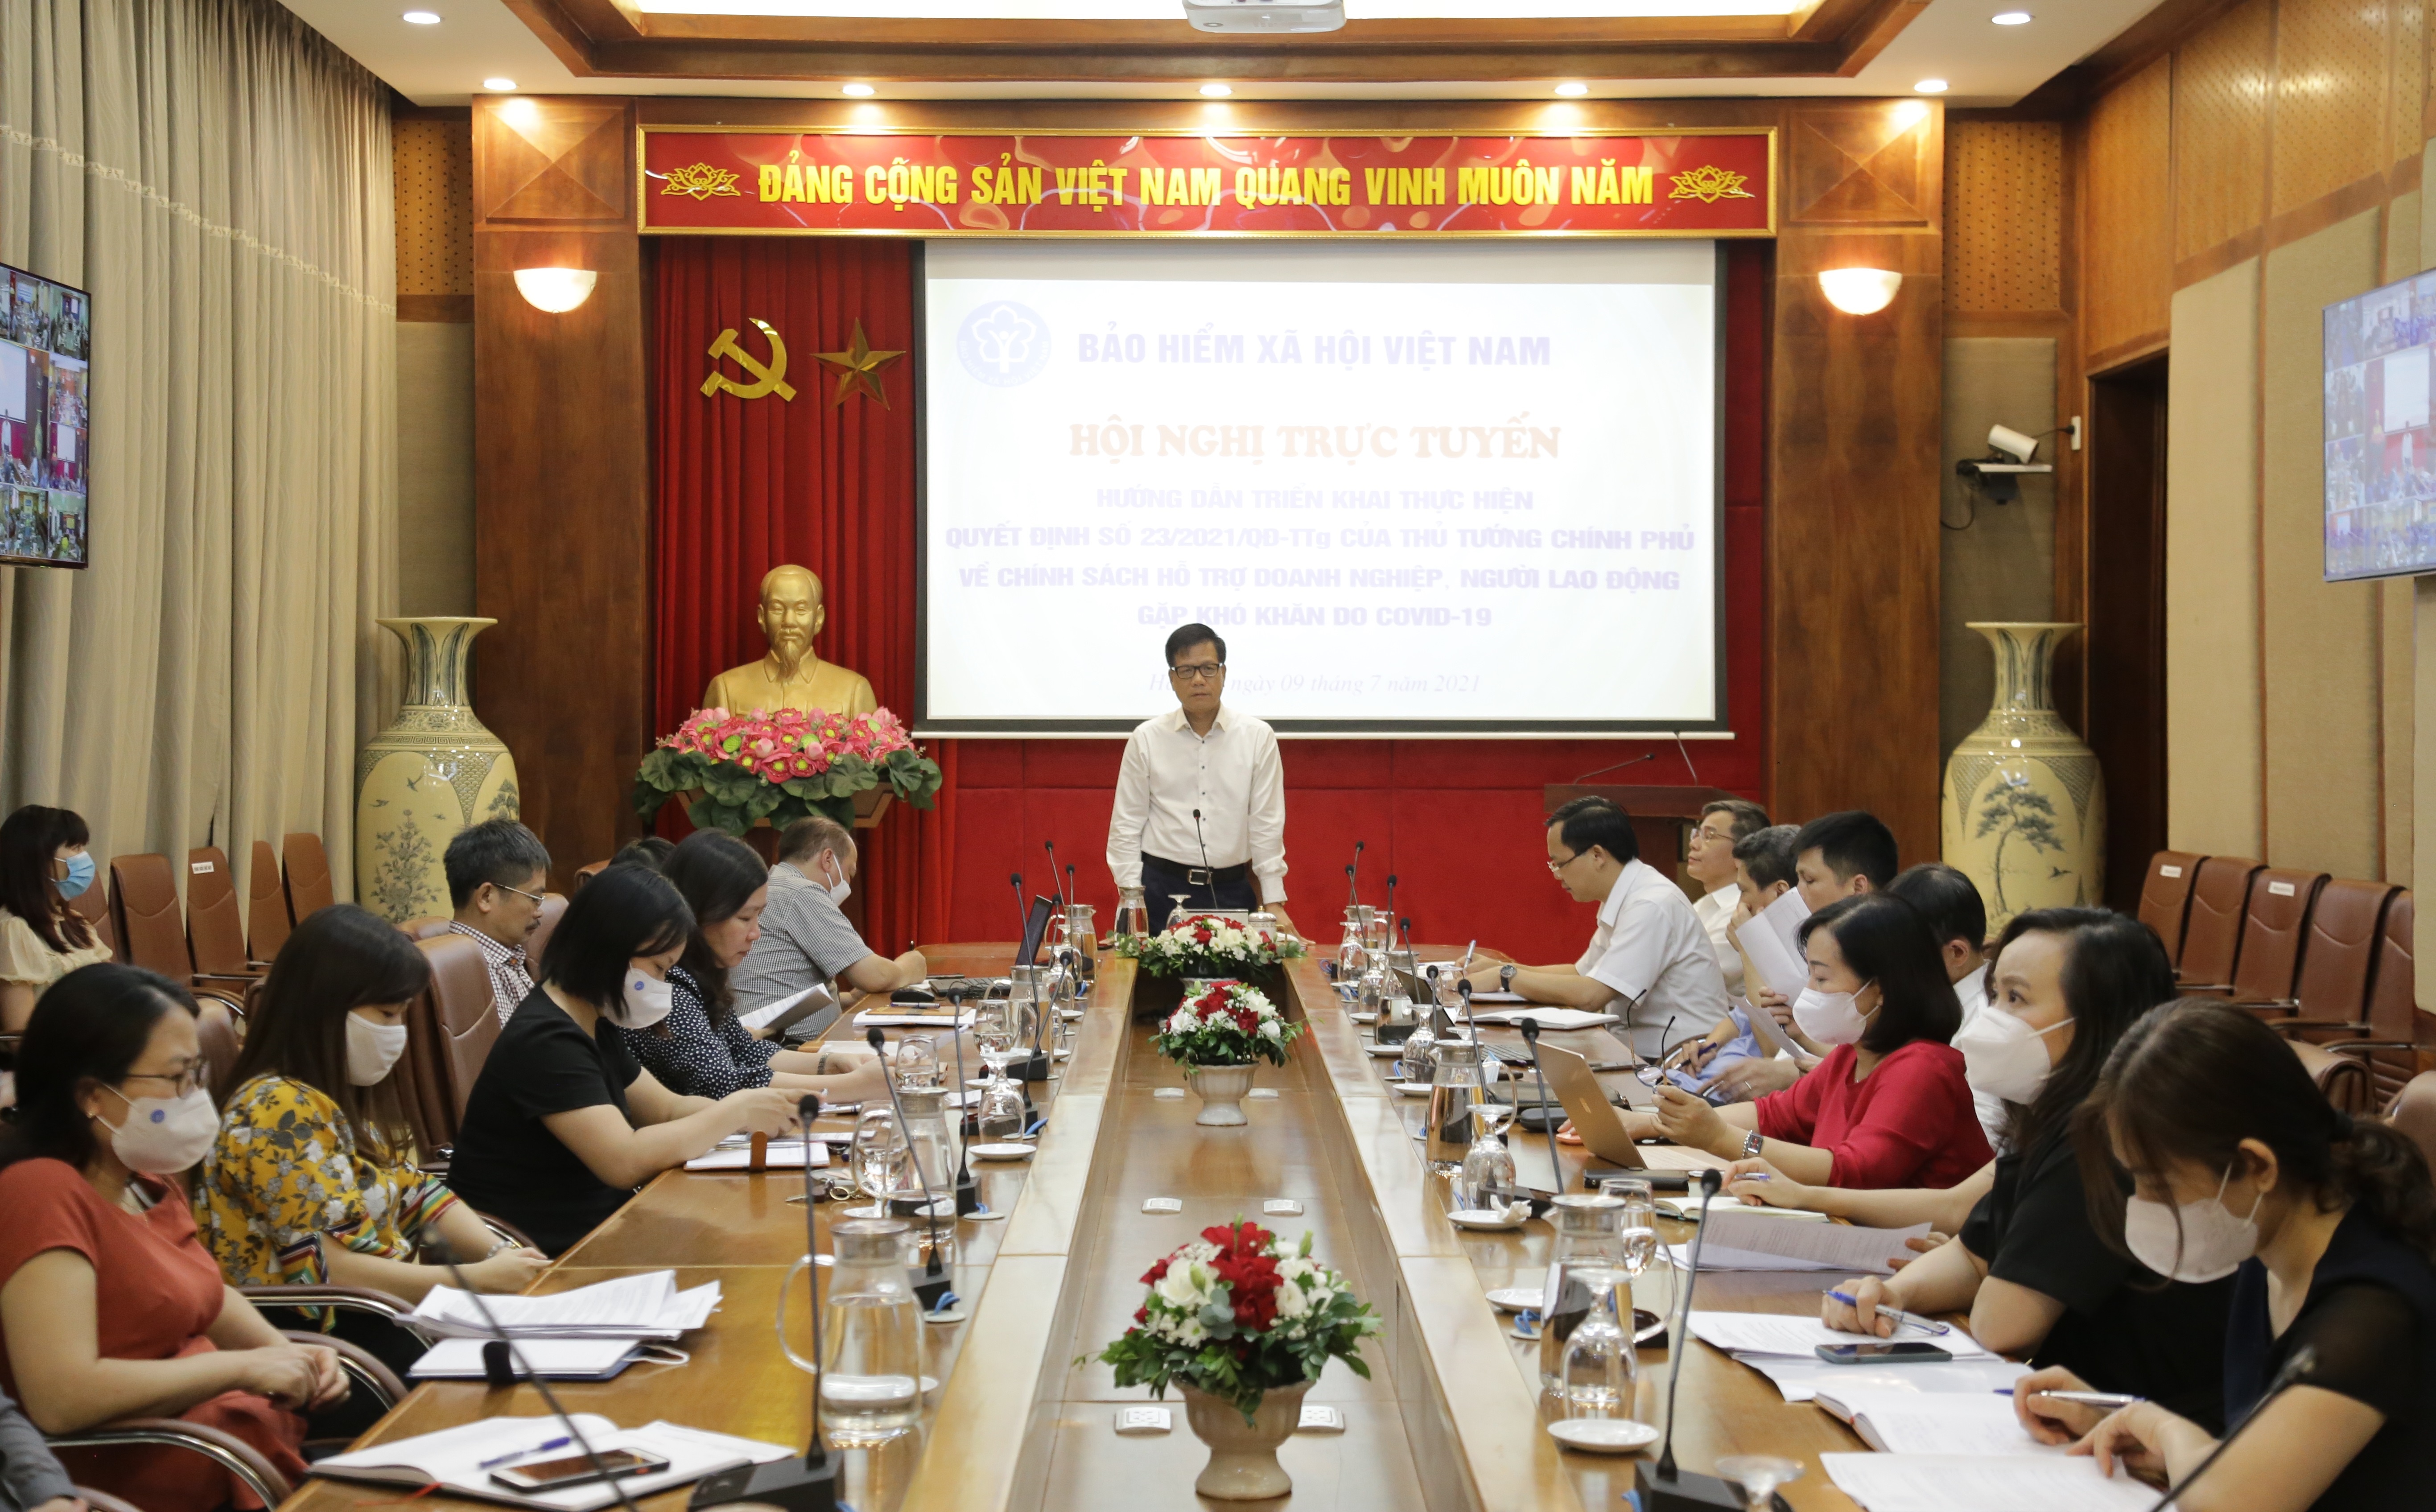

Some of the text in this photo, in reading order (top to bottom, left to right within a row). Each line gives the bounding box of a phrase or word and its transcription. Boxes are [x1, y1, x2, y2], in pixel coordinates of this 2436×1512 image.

[758, 150, 1655, 212] ĐẢNG CỘNG SẢN VIỆT NAM QUANG VINH MUÔN NĂM
[1079, 321, 1550, 371] BẢO HIỂM XÃ HỘI VIỆT NAM
[1070, 411, 1562, 466] HỘI NGHỊ TRỰC TUYẾN
[1096, 482, 1534, 514] HƯỚNG DẪN TRIỂN KHAI THỰC HIỆN
[946, 520, 1695, 551] QUYẾT ĐỊNH SỐ 23/2021/QĐ-TTg CỦA THỦ TƯỚNG CHÍNH PHỦ
[959, 560, 1680, 593] VỀ CHÍNH SÁCH HỖ TRỢ DOANH NGHIỆP, NGƯỜI LAO ĐỘNG
[1138, 601, 1492, 629] GẶP KHÓ KHĂN DO COVID-19
[1231, 675, 1275, 696] ngày
[1281, 674, 1304, 692] 09
[1311, 673, 1363, 696] tháng
[1370, 675, 1381, 692] 7
[1388, 675, 1428, 692] năm
[1433, 674, 1480, 692] 2021
